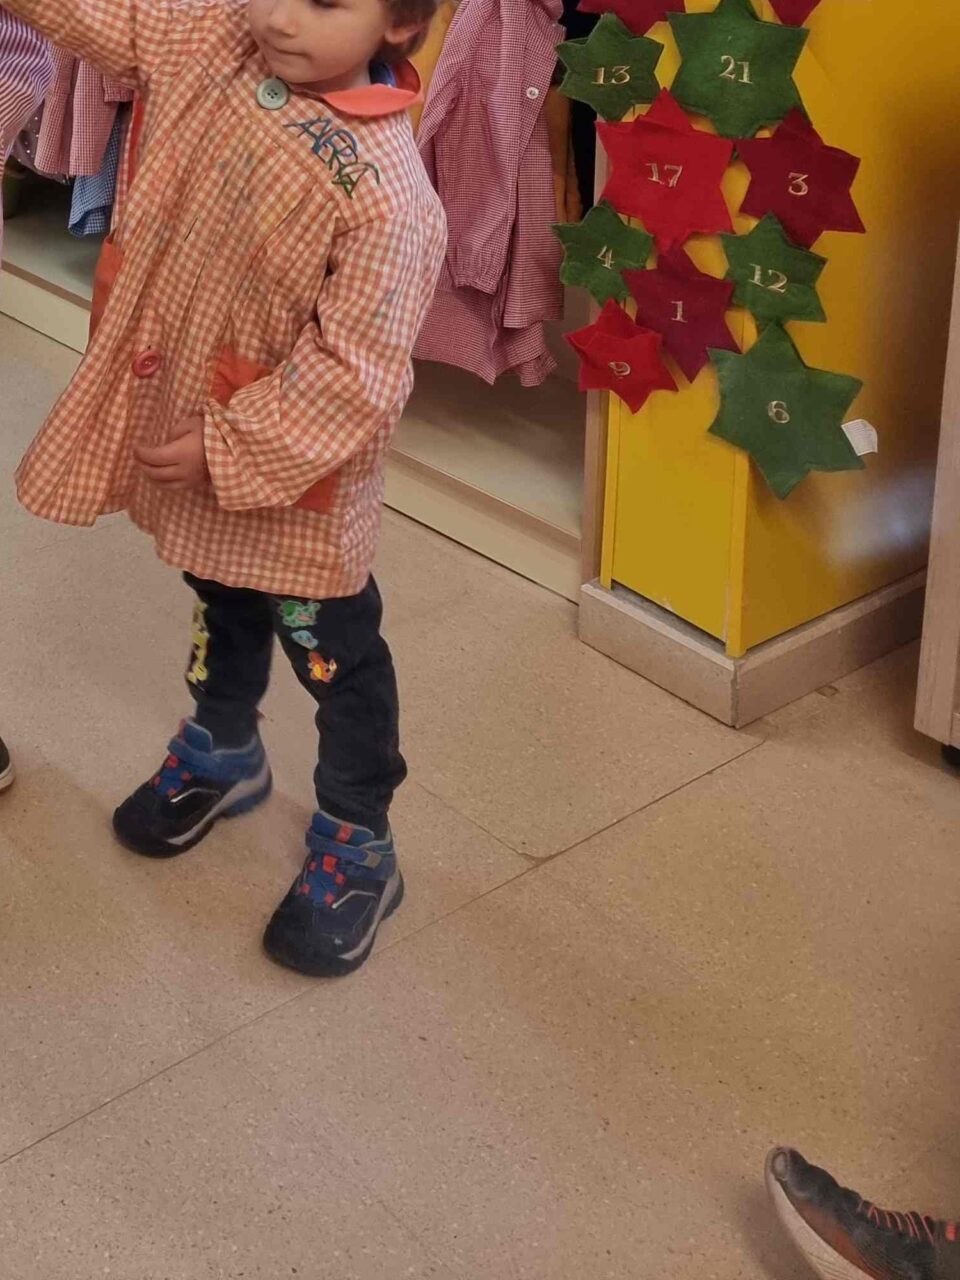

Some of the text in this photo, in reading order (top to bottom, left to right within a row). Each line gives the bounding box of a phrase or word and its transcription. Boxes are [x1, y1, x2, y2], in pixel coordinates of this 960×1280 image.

[594, 65, 631, 85] 13
[720, 55, 754, 83] 21
[646, 162, 682, 188] 17
[788, 172, 808, 195] 3
[597, 245, 615, 270] 4
[748, 264, 788, 292] 12
[671, 300, 687, 323] 1
[768, 400, 790, 424] 6
